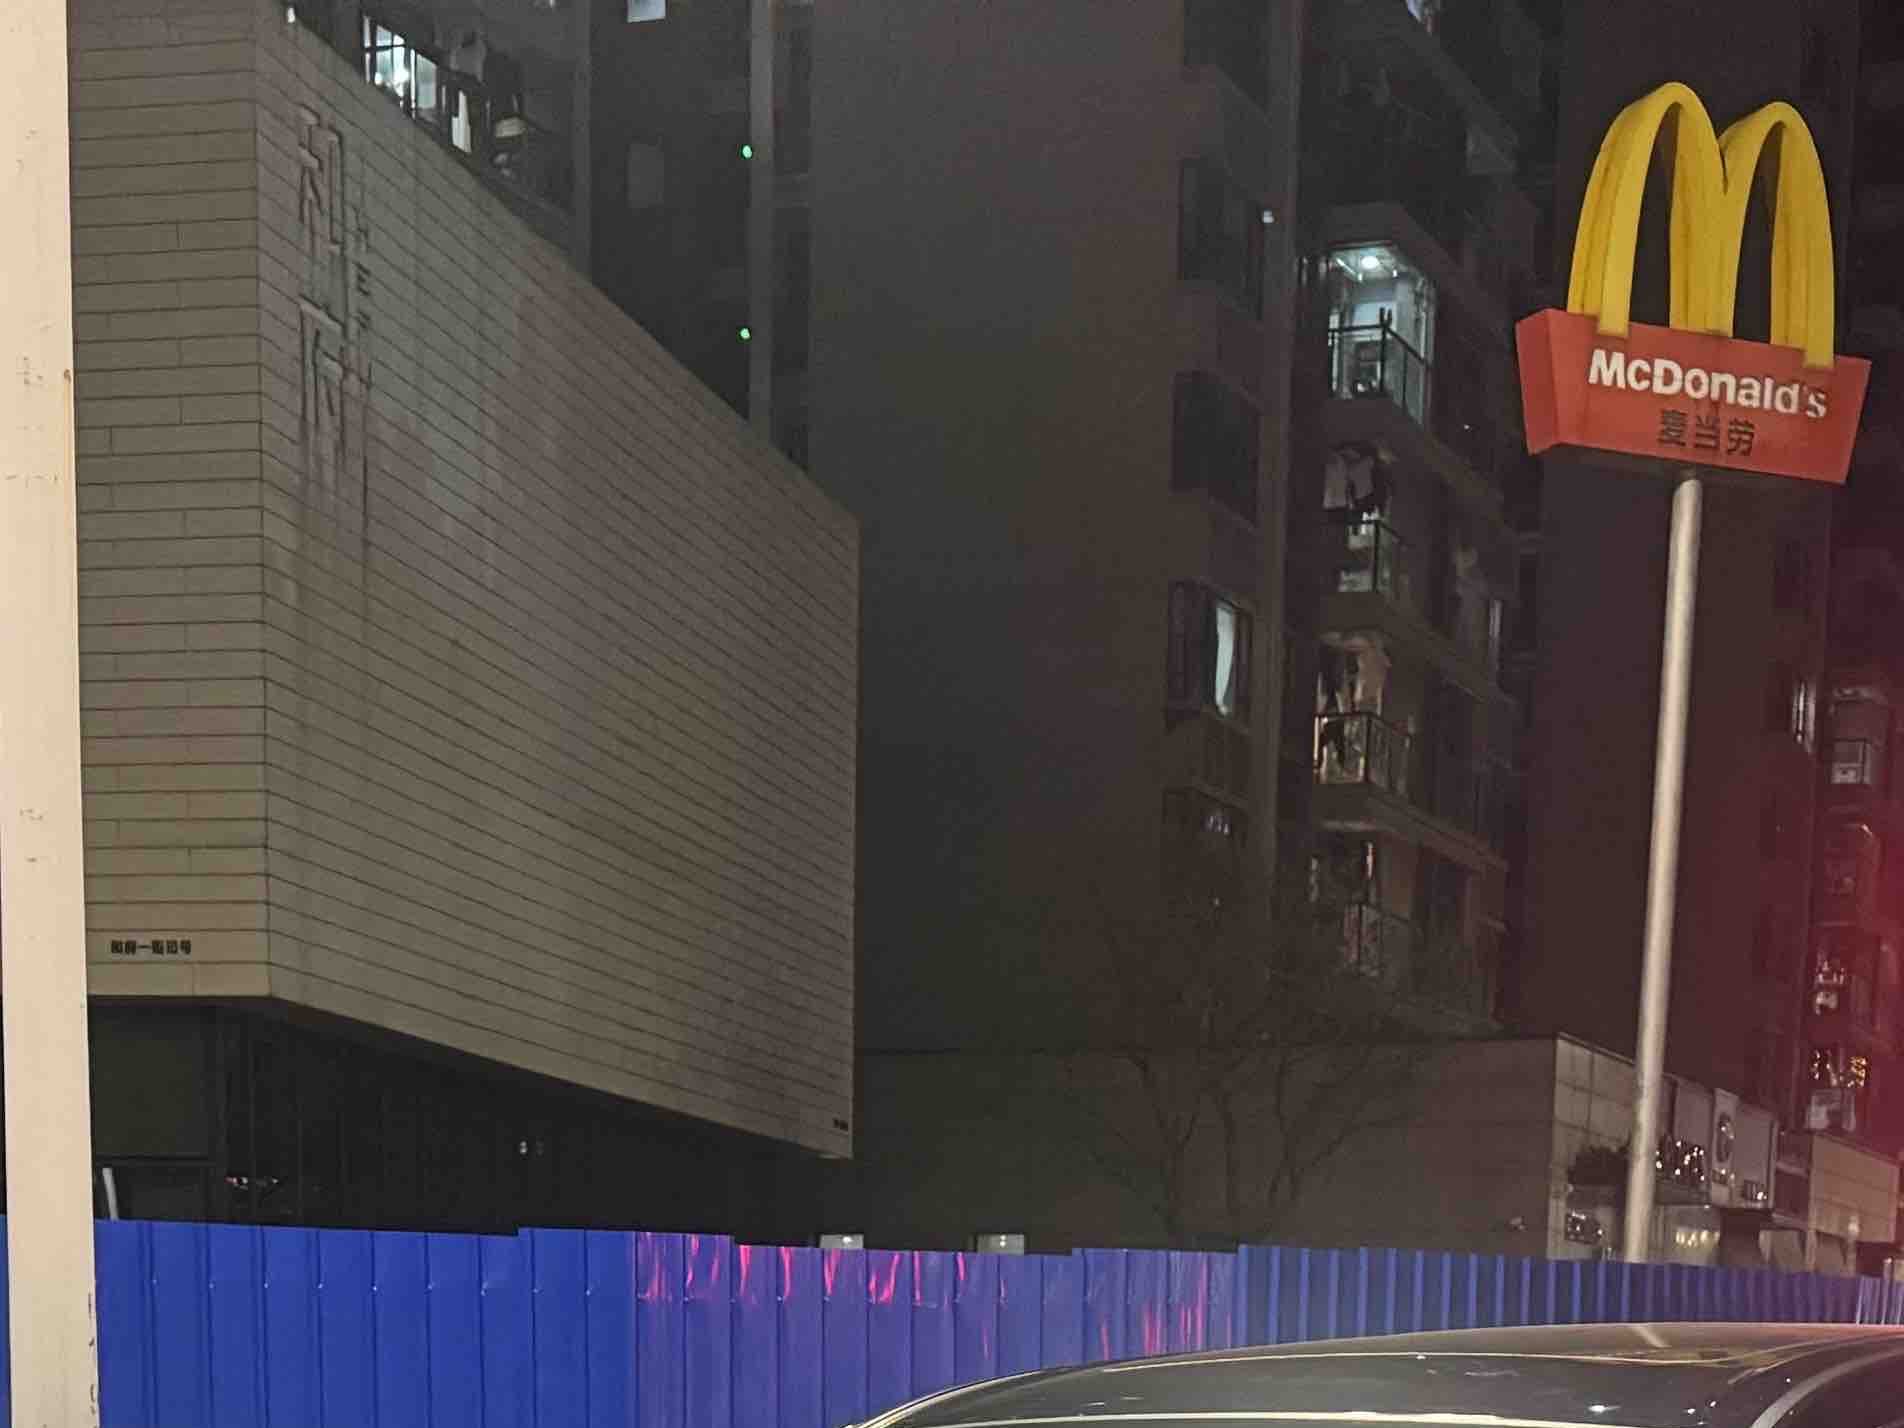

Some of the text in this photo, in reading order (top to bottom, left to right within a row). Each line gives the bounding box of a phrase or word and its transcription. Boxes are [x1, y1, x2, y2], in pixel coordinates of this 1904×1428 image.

[1587, 348, 1828, 420] McDonald's
[1657, 409, 1756, 457] 麦当劳
